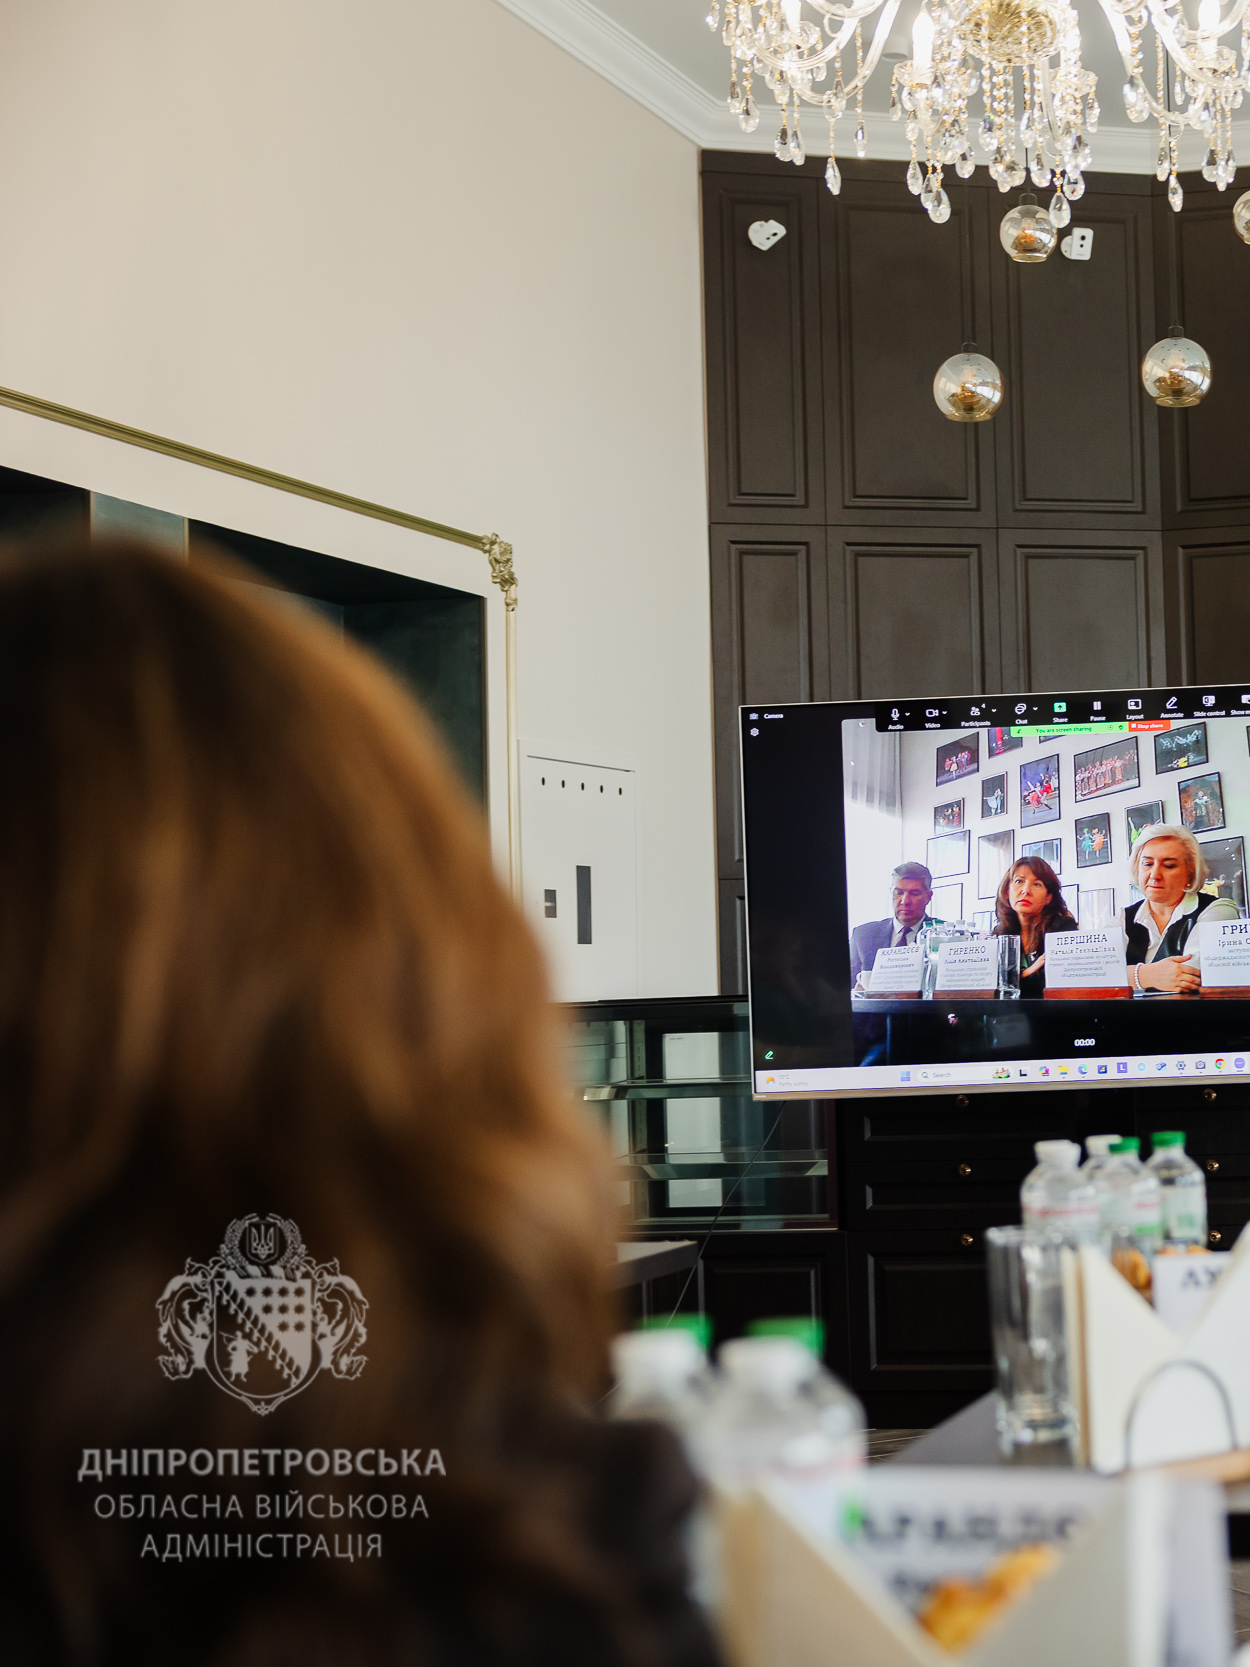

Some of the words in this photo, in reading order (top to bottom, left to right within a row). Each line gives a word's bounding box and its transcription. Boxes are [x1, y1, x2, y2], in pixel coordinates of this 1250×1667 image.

[1056, 934, 1108, 946] ПЕРШИНА
[1218, 939, 1242, 947] Ірина
[948, 945, 987, 956] ГИРЕНКО
[1074, 1038, 1096, 1047] 00:00
